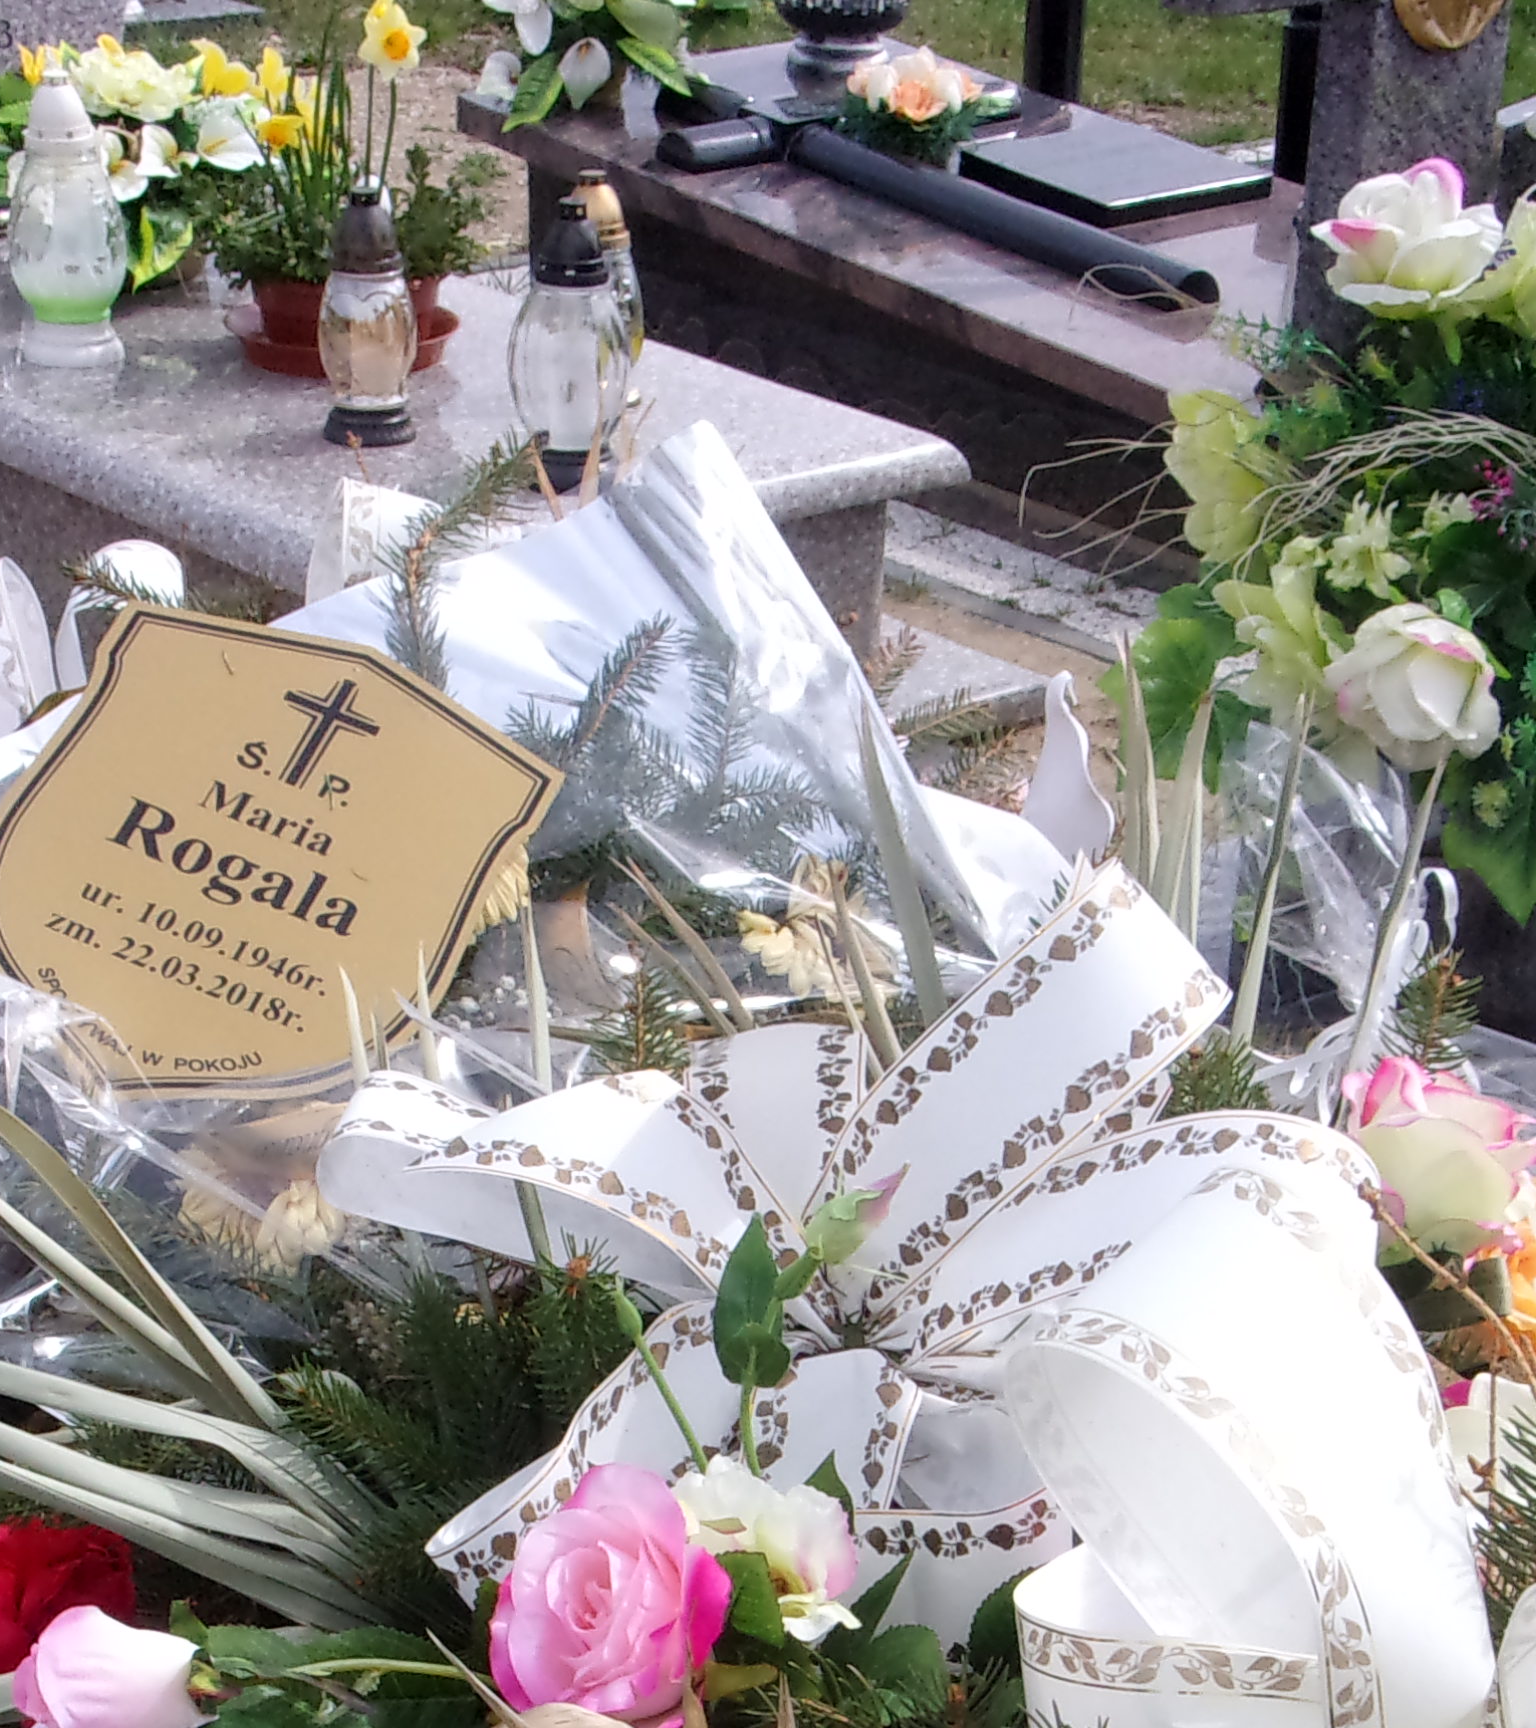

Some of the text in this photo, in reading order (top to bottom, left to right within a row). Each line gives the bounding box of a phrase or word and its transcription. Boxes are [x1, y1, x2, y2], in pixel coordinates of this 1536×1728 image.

[198, 779, 334, 856] Maria
[318, 774, 350, 807] P.
[106, 795, 358, 937] Rogala
[44, 911, 305, 1034] zm. 22.03.2018r.
[80, 882, 326, 997] ur. 10.09.1946r.
[141, 1050, 164, 1067] W
[173, 1051, 263, 1073] POKOJU
